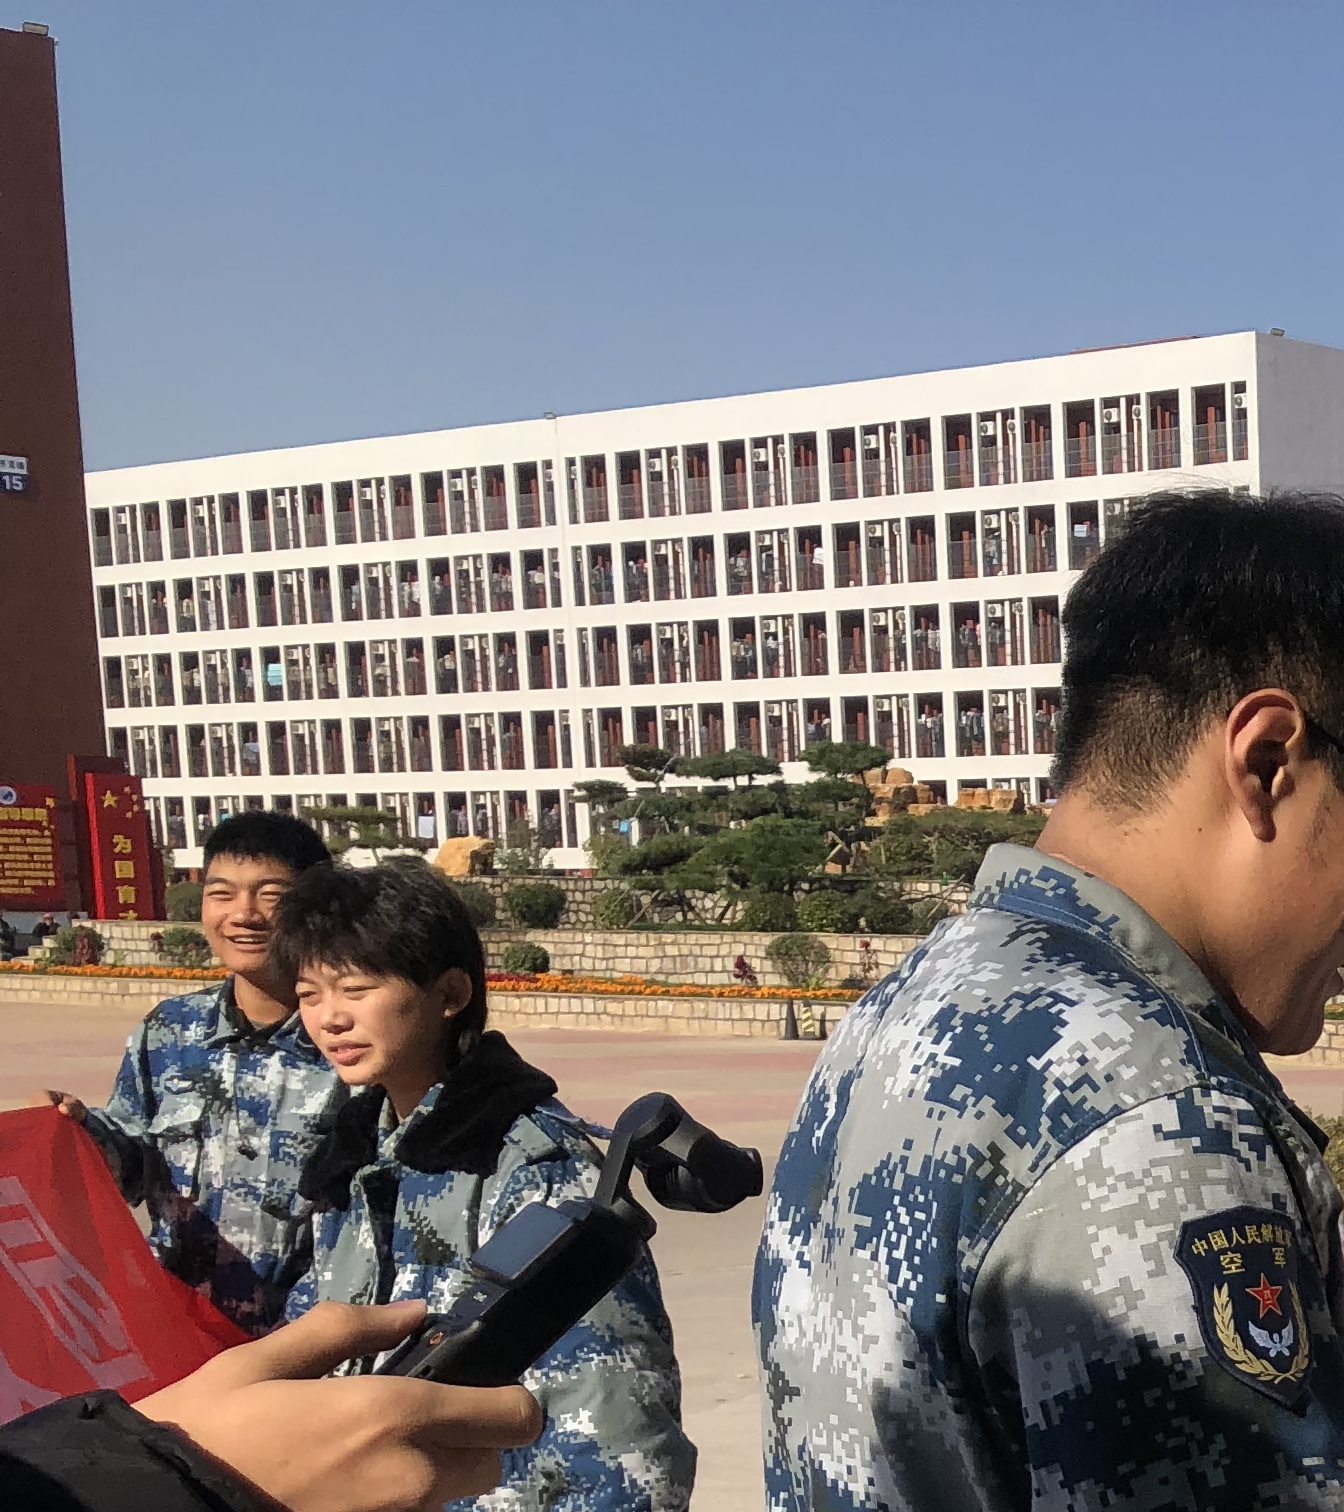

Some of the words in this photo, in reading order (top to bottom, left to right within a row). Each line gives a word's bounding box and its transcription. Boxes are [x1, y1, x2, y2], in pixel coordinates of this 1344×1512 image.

[2, 475, 23, 490] 15
[1191, 1223, 1293, 1257] 中国人民解放军
[1220, 1247, 1287, 1275] 空军
